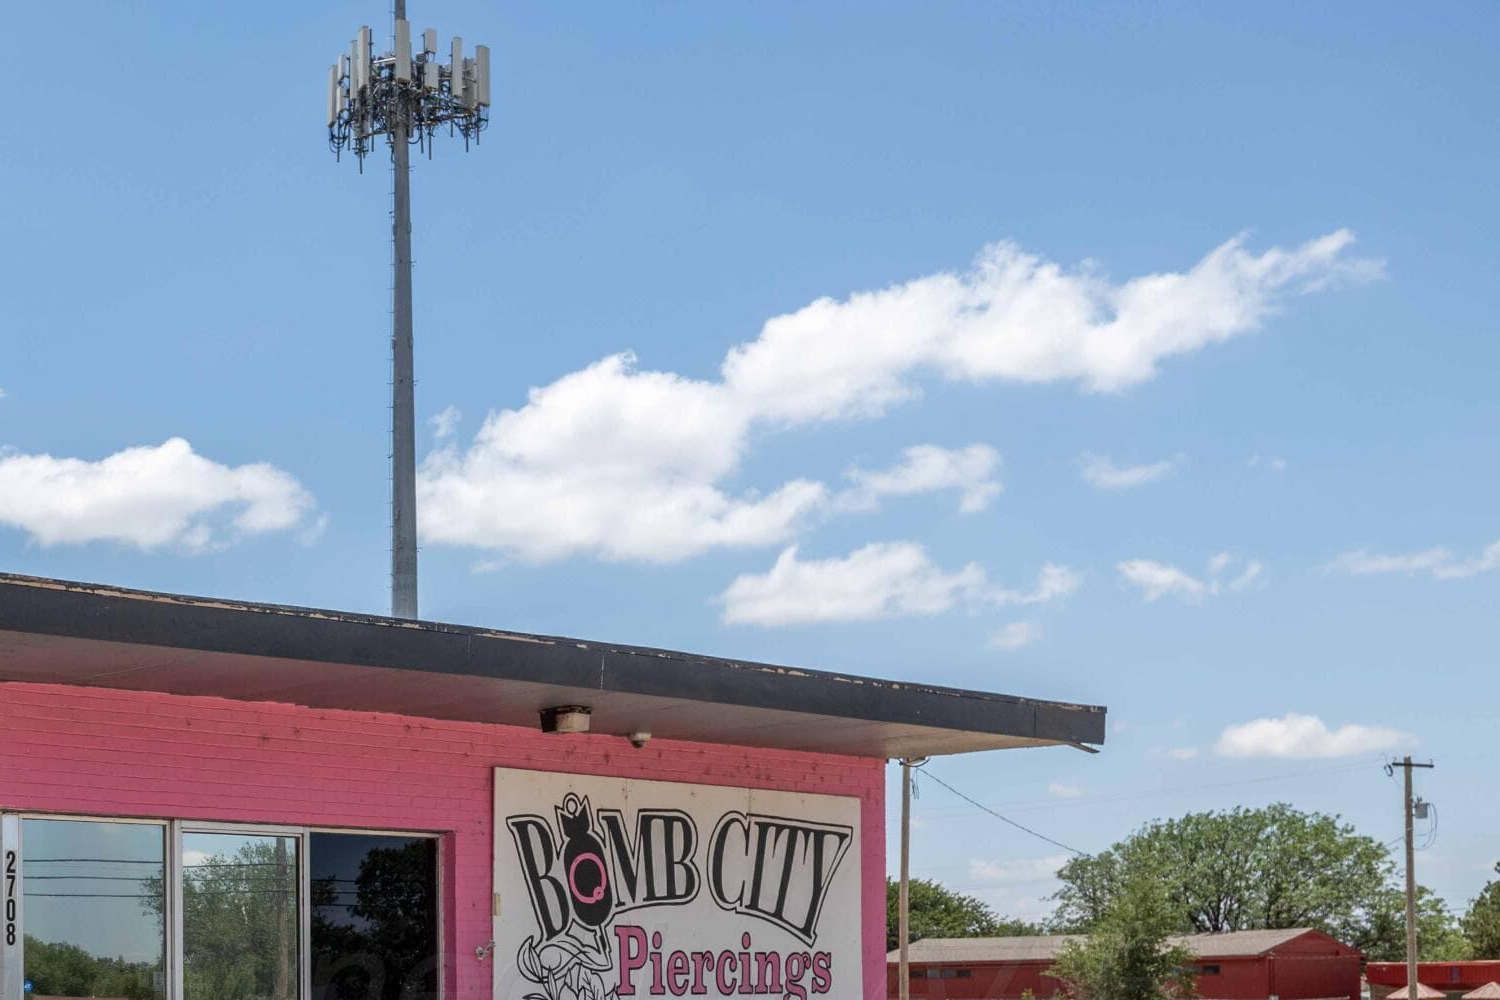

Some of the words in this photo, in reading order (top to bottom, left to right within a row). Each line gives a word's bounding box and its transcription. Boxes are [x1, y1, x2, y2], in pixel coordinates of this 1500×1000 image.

[6, 850, 16, 946] 2708
[506, 793, 700, 943] BOMB
[706, 811, 853, 946] CITY
